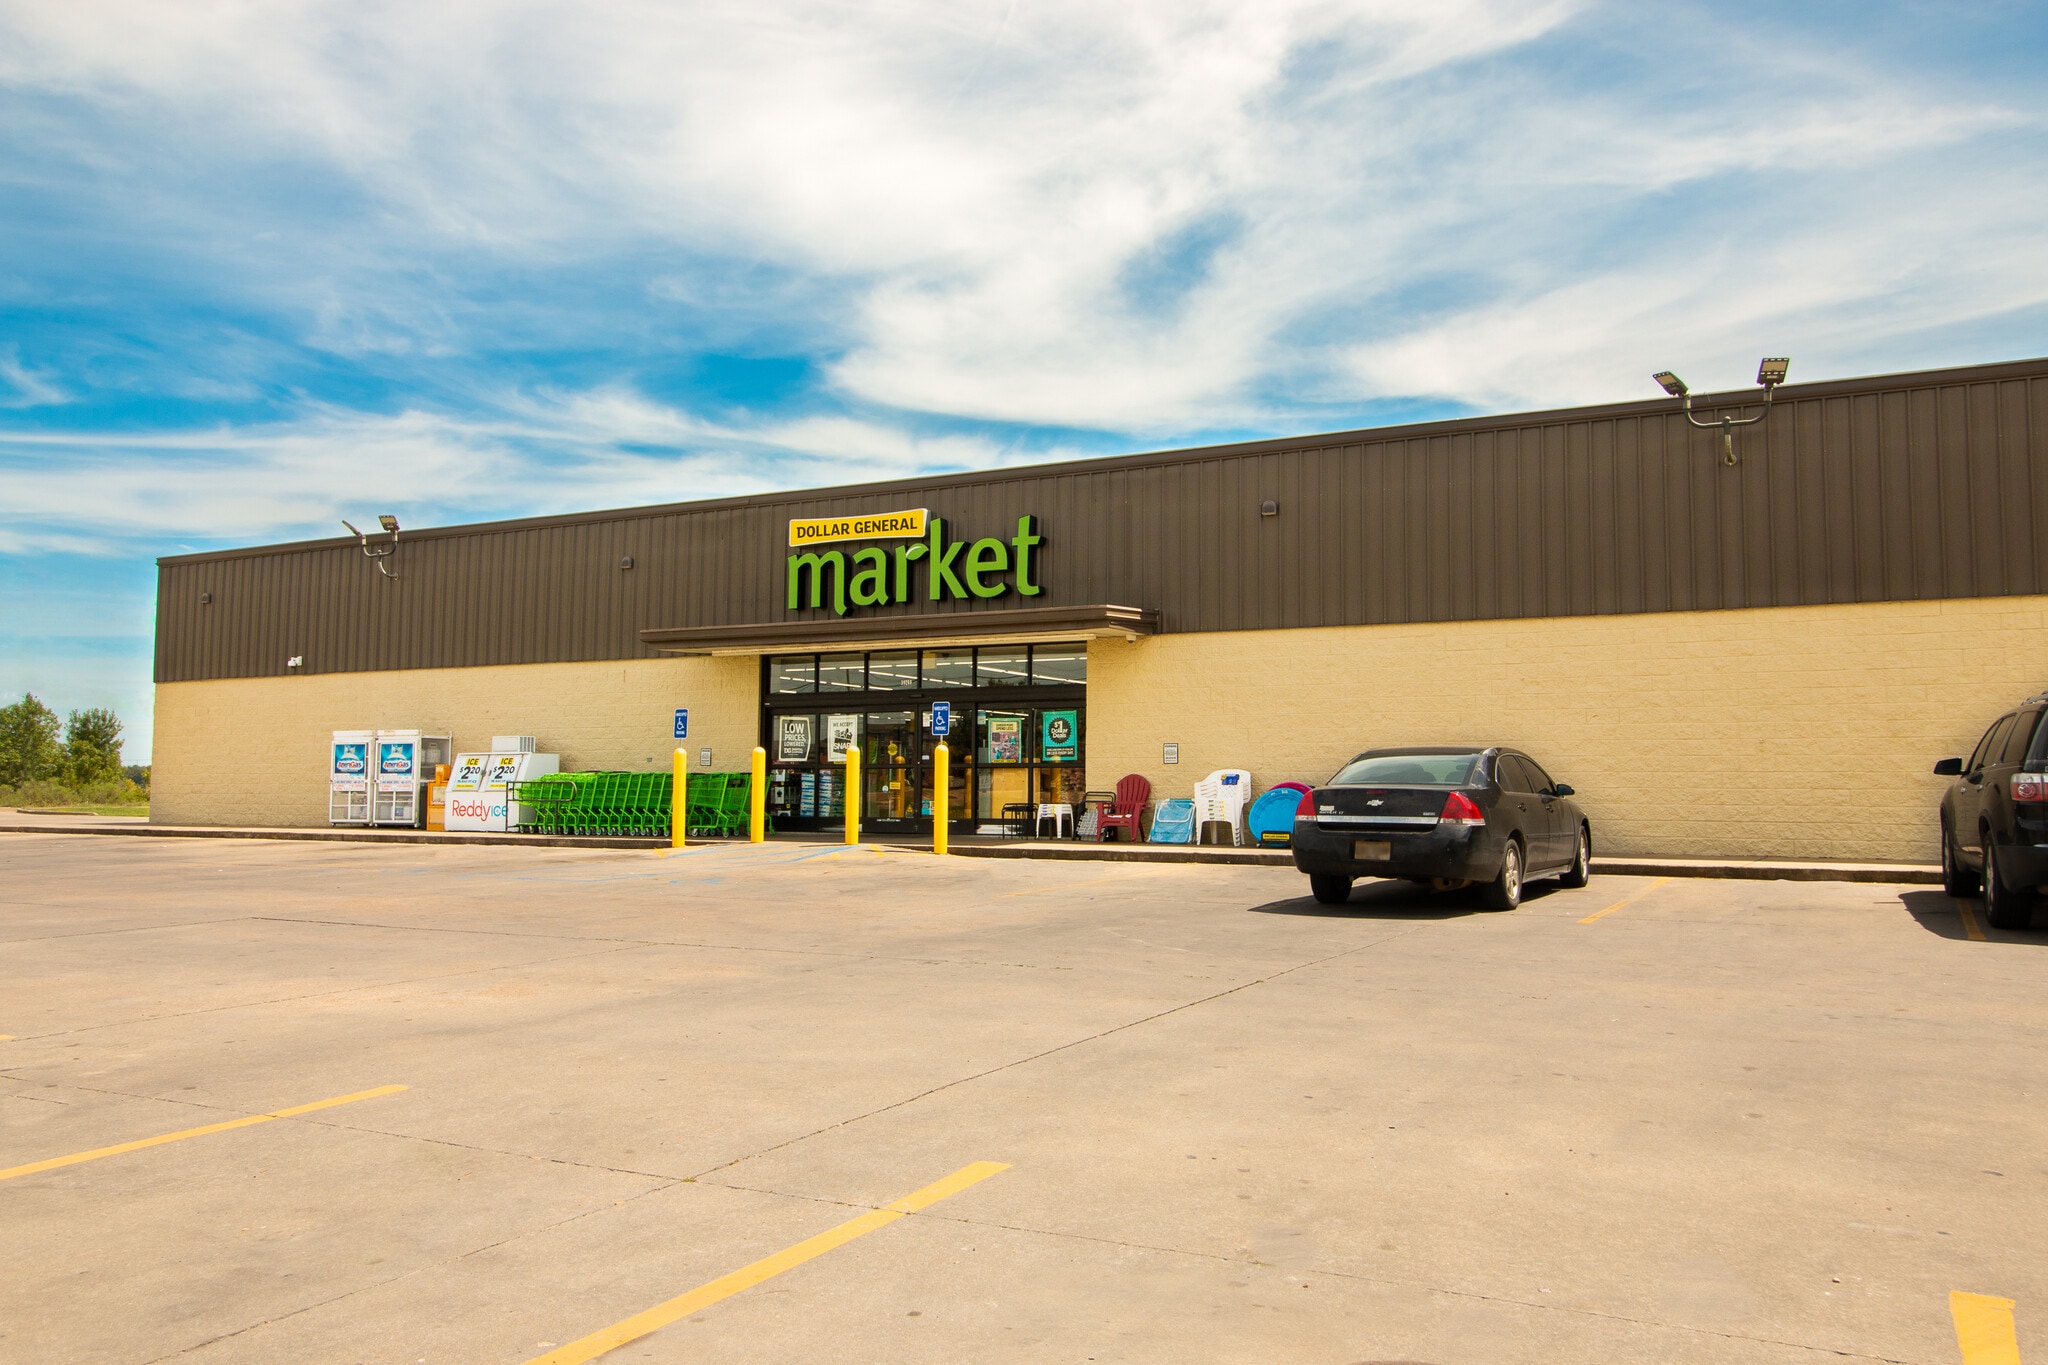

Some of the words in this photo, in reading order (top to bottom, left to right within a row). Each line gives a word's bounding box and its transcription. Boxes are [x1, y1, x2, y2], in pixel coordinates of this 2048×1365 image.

[796, 520, 850, 539] DOLLAR
[854, 516, 918, 533] GENERAL
[787, 514, 1042, 616] market
[784, 723, 805, 734] LOW
[500, 757, 514, 765] ICE
